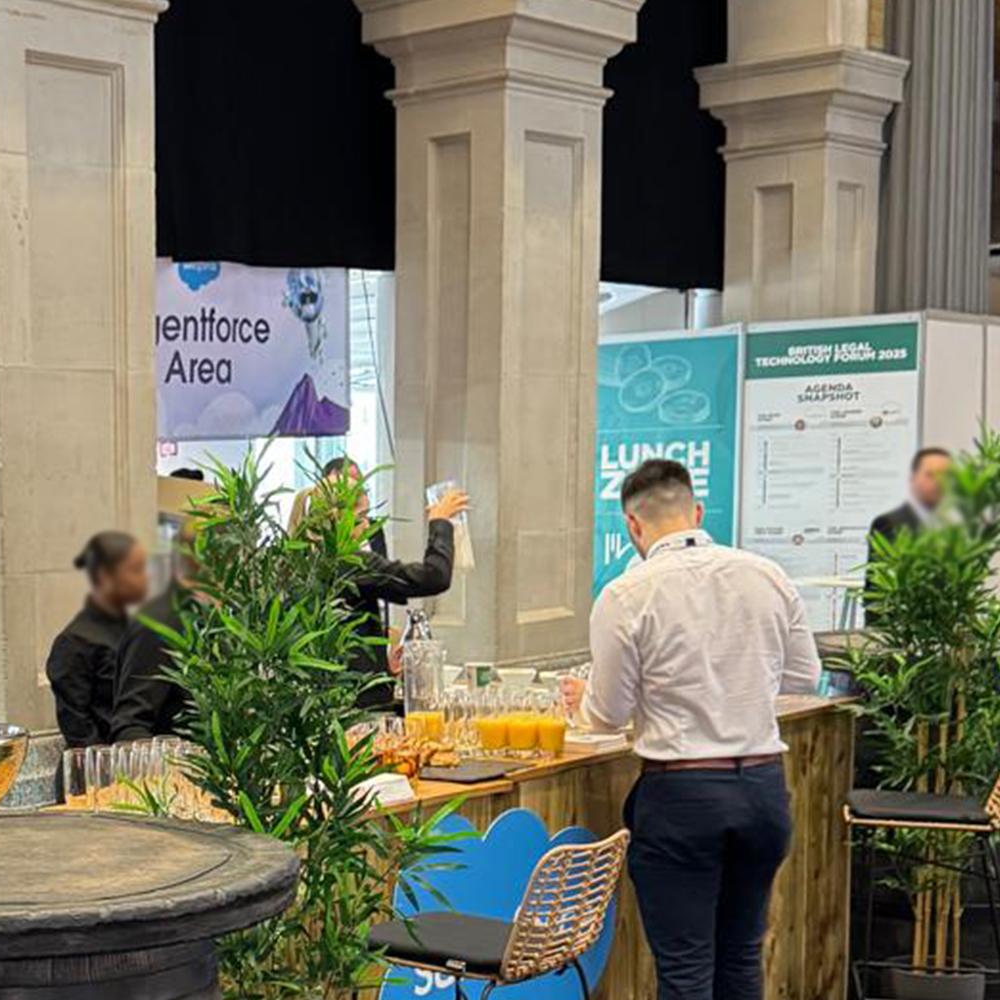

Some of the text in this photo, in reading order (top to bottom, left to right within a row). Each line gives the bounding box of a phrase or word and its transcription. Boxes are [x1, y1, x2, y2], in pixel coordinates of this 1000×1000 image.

[755, 348, 908, 367] TECHNOLOGY FORUM 2025
[788, 341, 873, 356] BRITISH LEGAL
[164, 350, 232, 384] Area
[797, 391, 861, 403] SNAPSHOT
[804, 384, 853, 393] AGENDA
[601, 440, 710, 469] LUNCH
[600, 466, 709, 499] ZE
